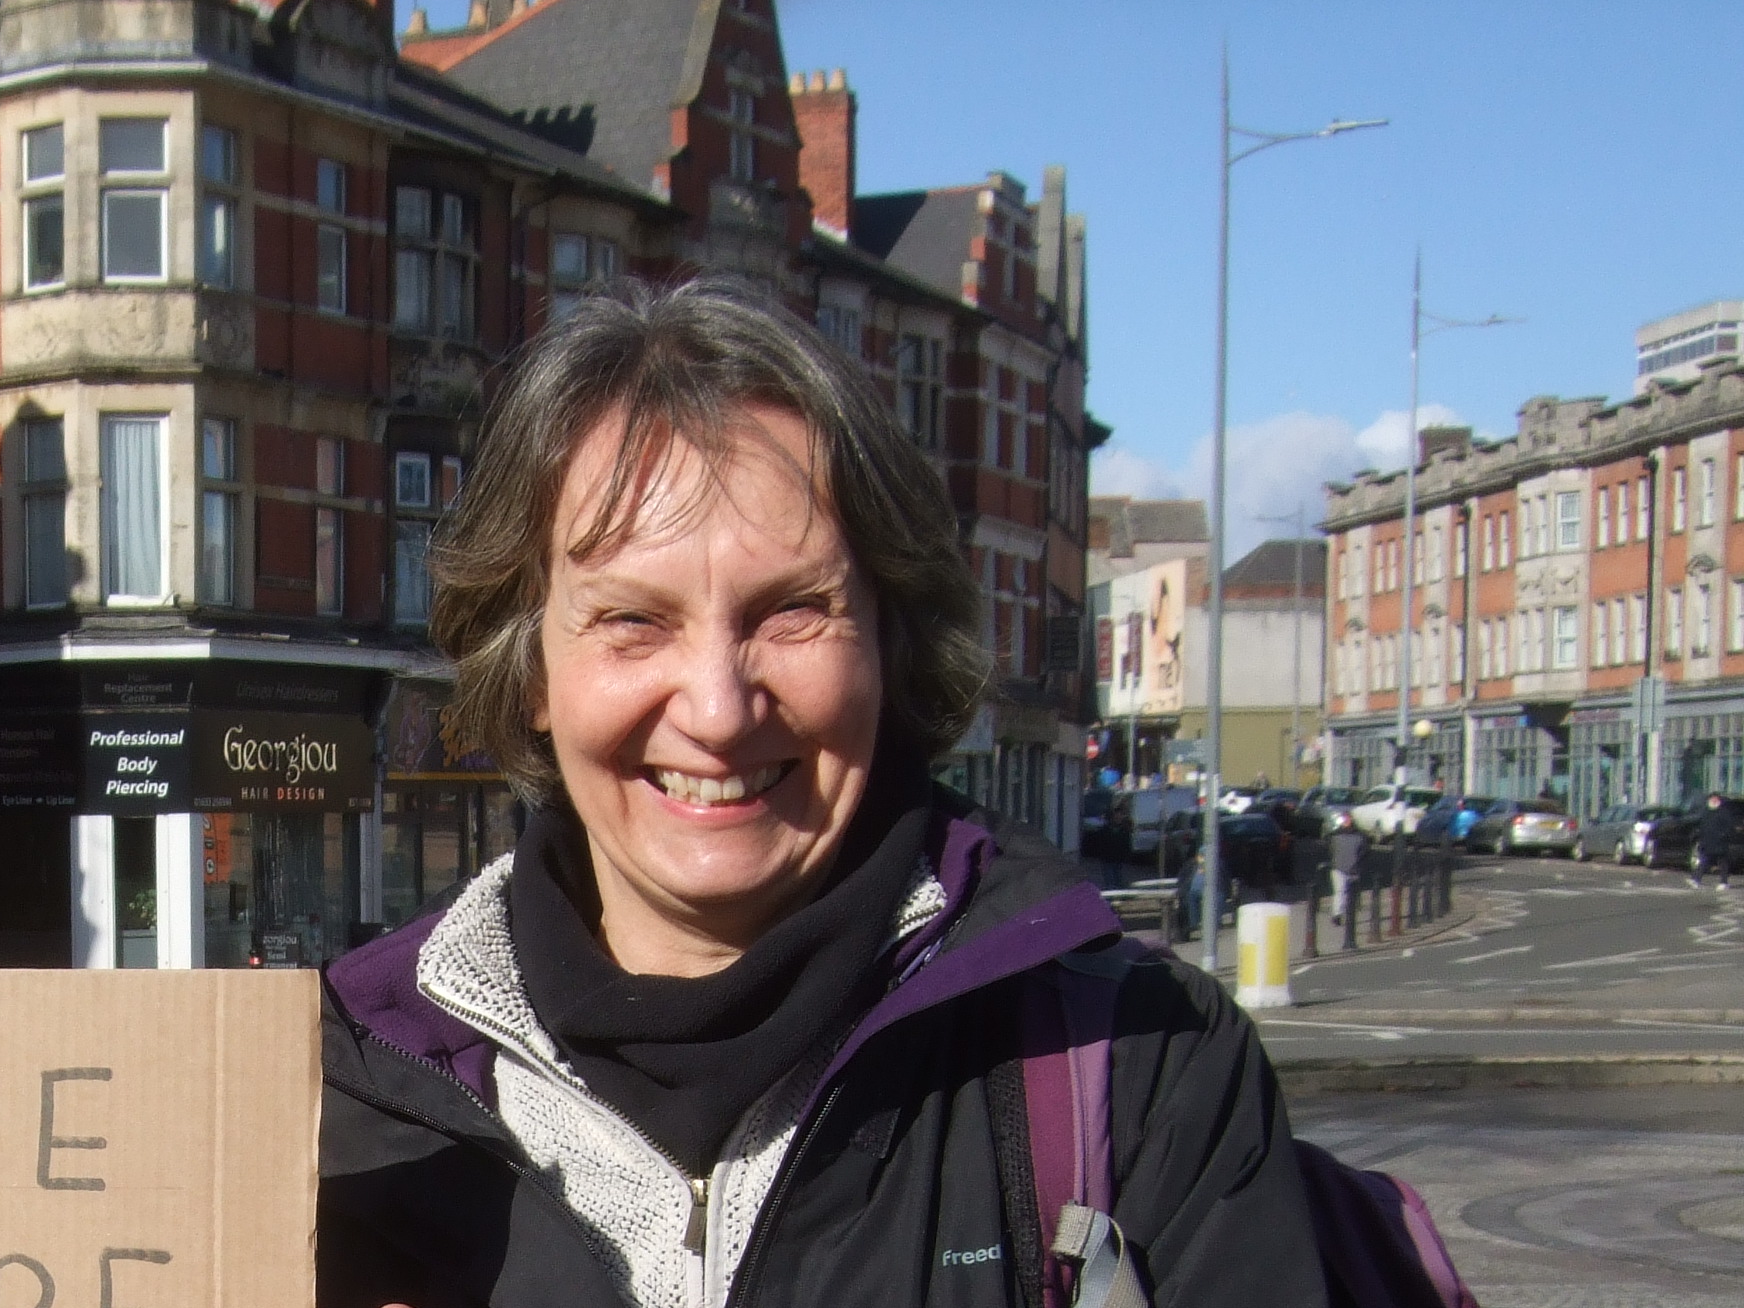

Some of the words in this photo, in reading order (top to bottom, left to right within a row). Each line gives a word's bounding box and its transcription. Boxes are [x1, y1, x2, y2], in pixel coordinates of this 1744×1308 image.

[104, 683, 173, 694] Replacement
[90, 729, 184, 746] Professional
[223, 724, 337, 784] Georgiou
[117, 756, 158, 774] Body
[106, 780, 169, 798] Piercing
[241, 787, 269, 800] HAIR
[277, 787, 326, 801] DESIGN
